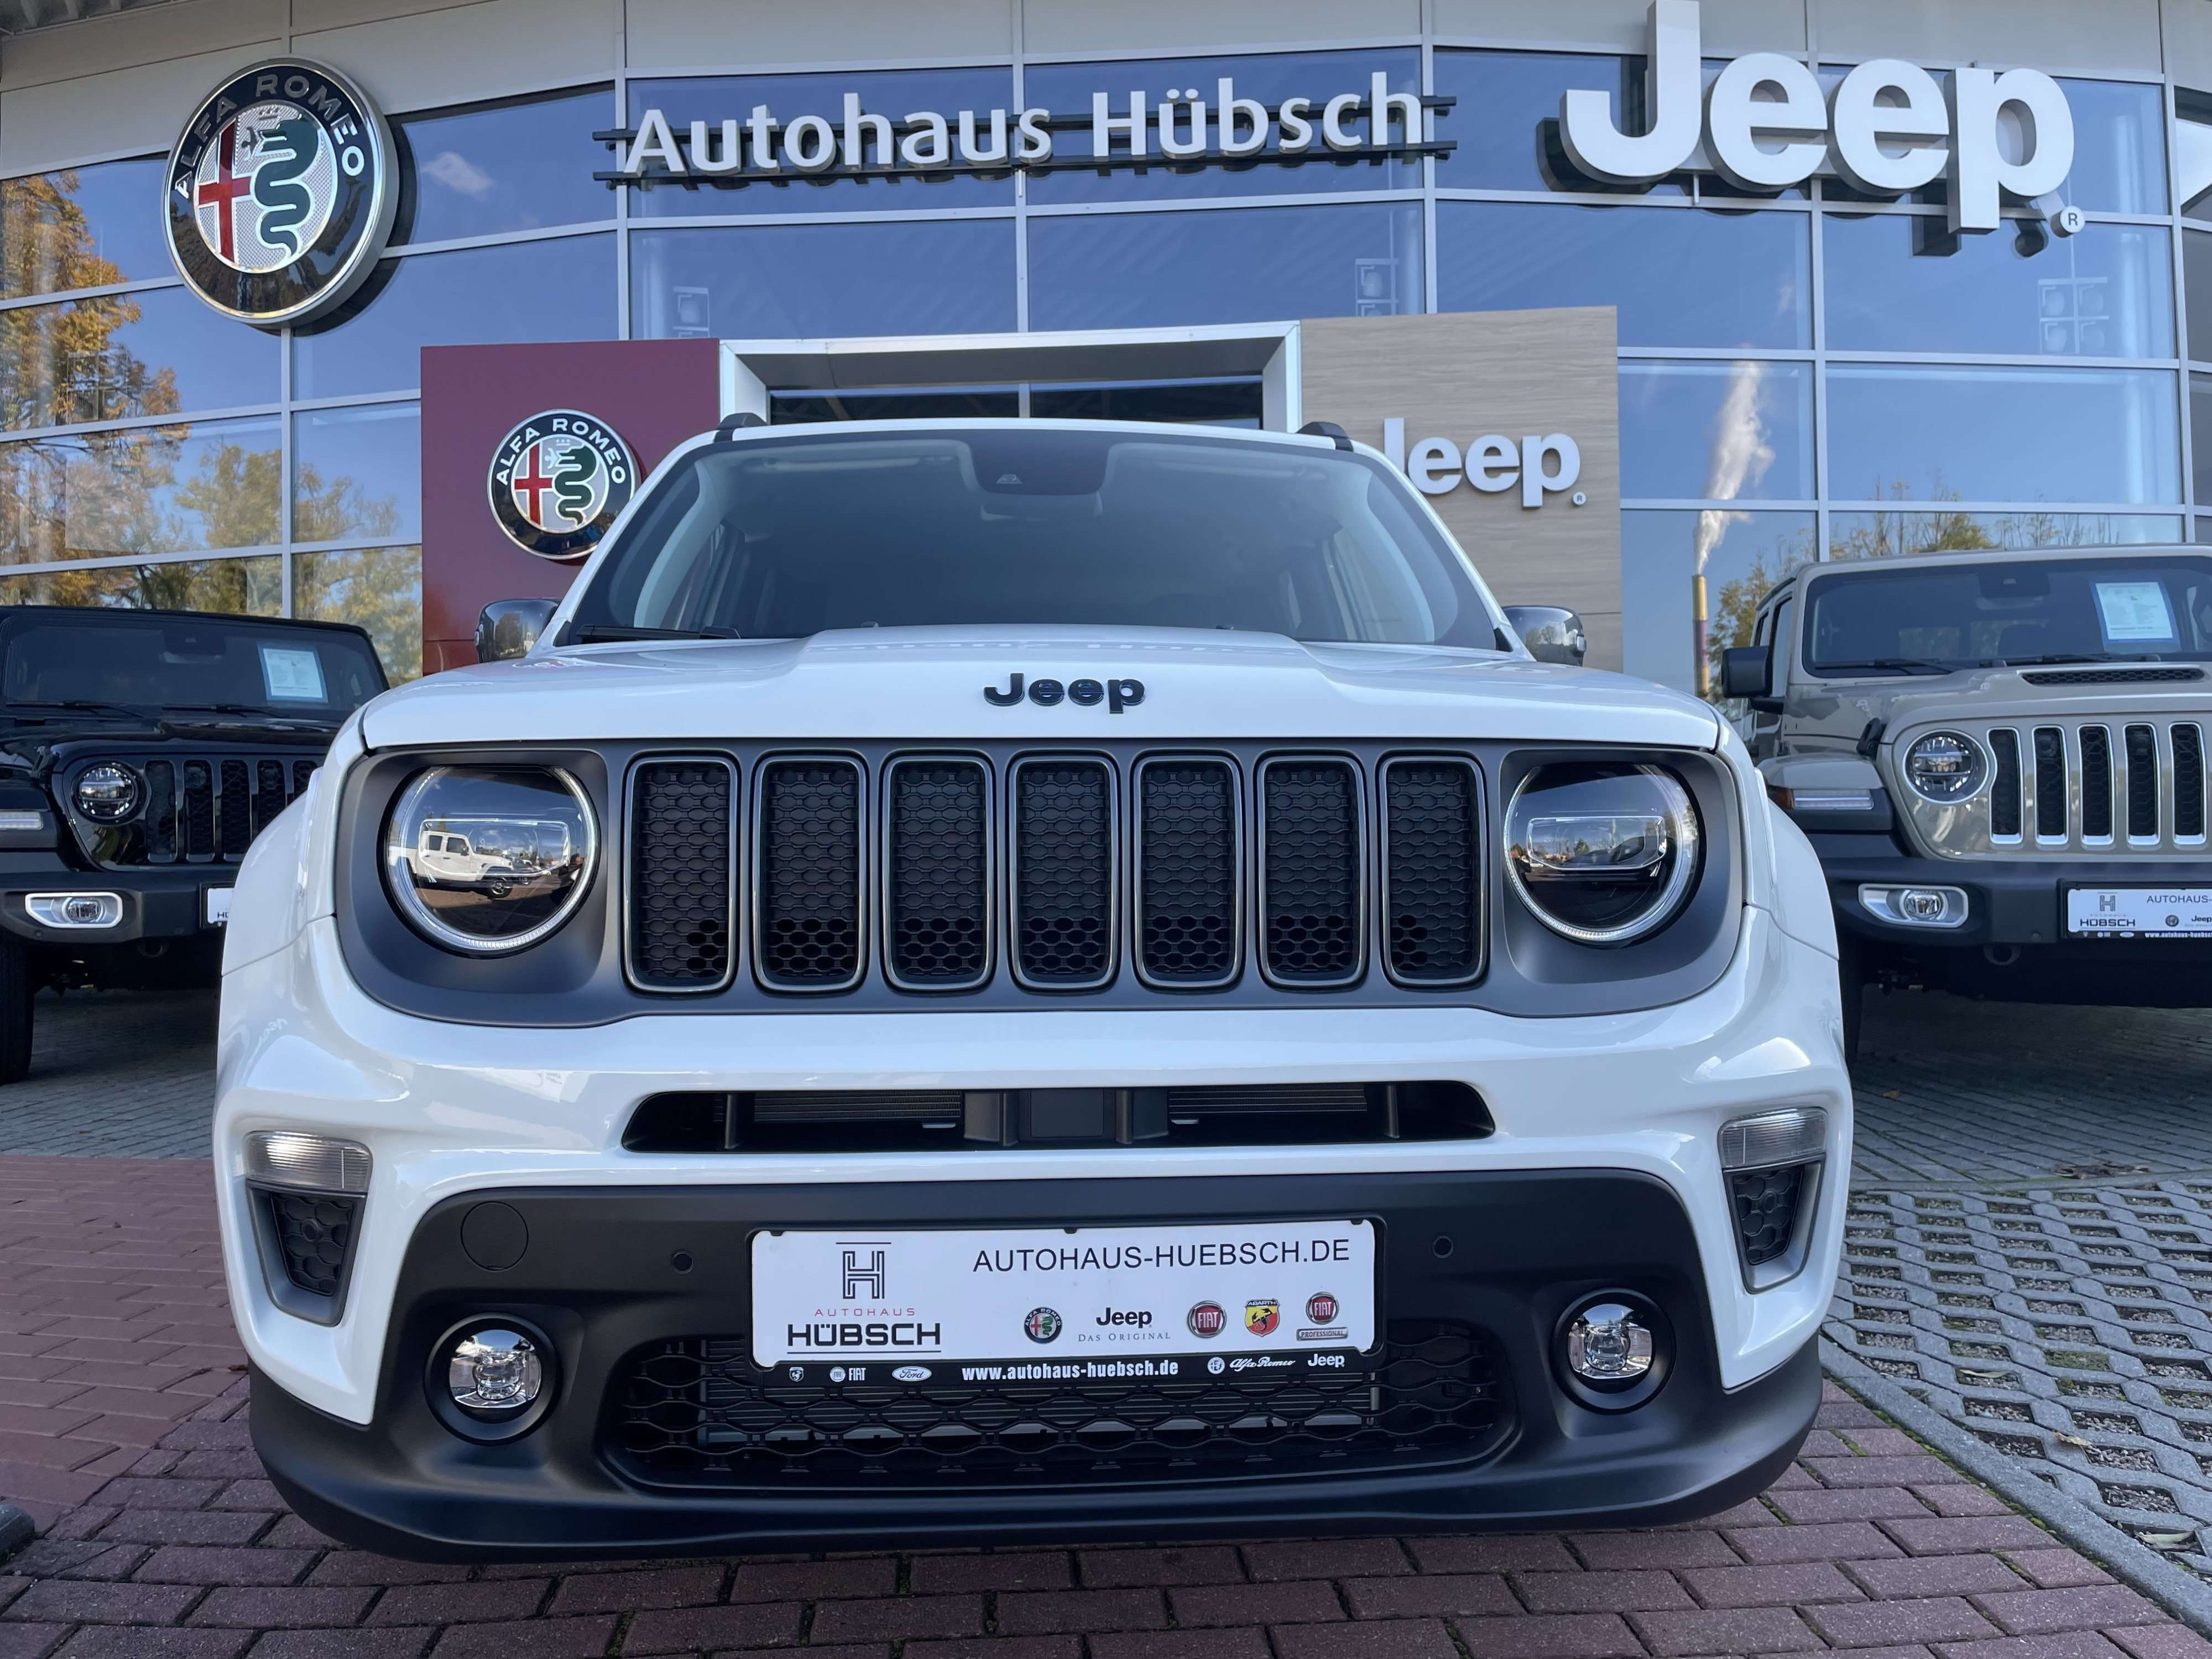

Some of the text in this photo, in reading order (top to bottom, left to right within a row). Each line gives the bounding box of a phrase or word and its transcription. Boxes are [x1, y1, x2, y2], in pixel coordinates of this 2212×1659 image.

[623, 71, 1425, 176] Autohaus Hübsch
[1560, 0, 2074, 234] Jeep
[175, 74, 365, 200] ALFA ROMEO
[496, 418, 626, 486] ALFA ROMEO
[984, 673, 1146, 714] Jeep
[2080, 919, 2136, 927] HÜBSCH
[973, 1239, 1349, 1272] AUTOHAUS-HUEBSCH.DE
[815, 1308, 915, 1317] AUTOHAUS
[1025, 1308, 1061, 1326] ALFA ROMEO
[1096, 1307, 1152, 1328] Jeep
[1314, 1301, 1332, 1316] FIAT
[1197, 1312, 1218, 1328] FIAT
[787, 1323, 941, 1346] HÜBSCH
[962, 1360, 1178, 1381] www.autohaus-huebsch.de
[1229, 1357, 1296, 1371] Alfa Romeo
[1308, 1354, 1345, 1368] Jeep
[849, 1368, 866, 1381] FIAT
[899, 1369, 924, 1379] Ford
